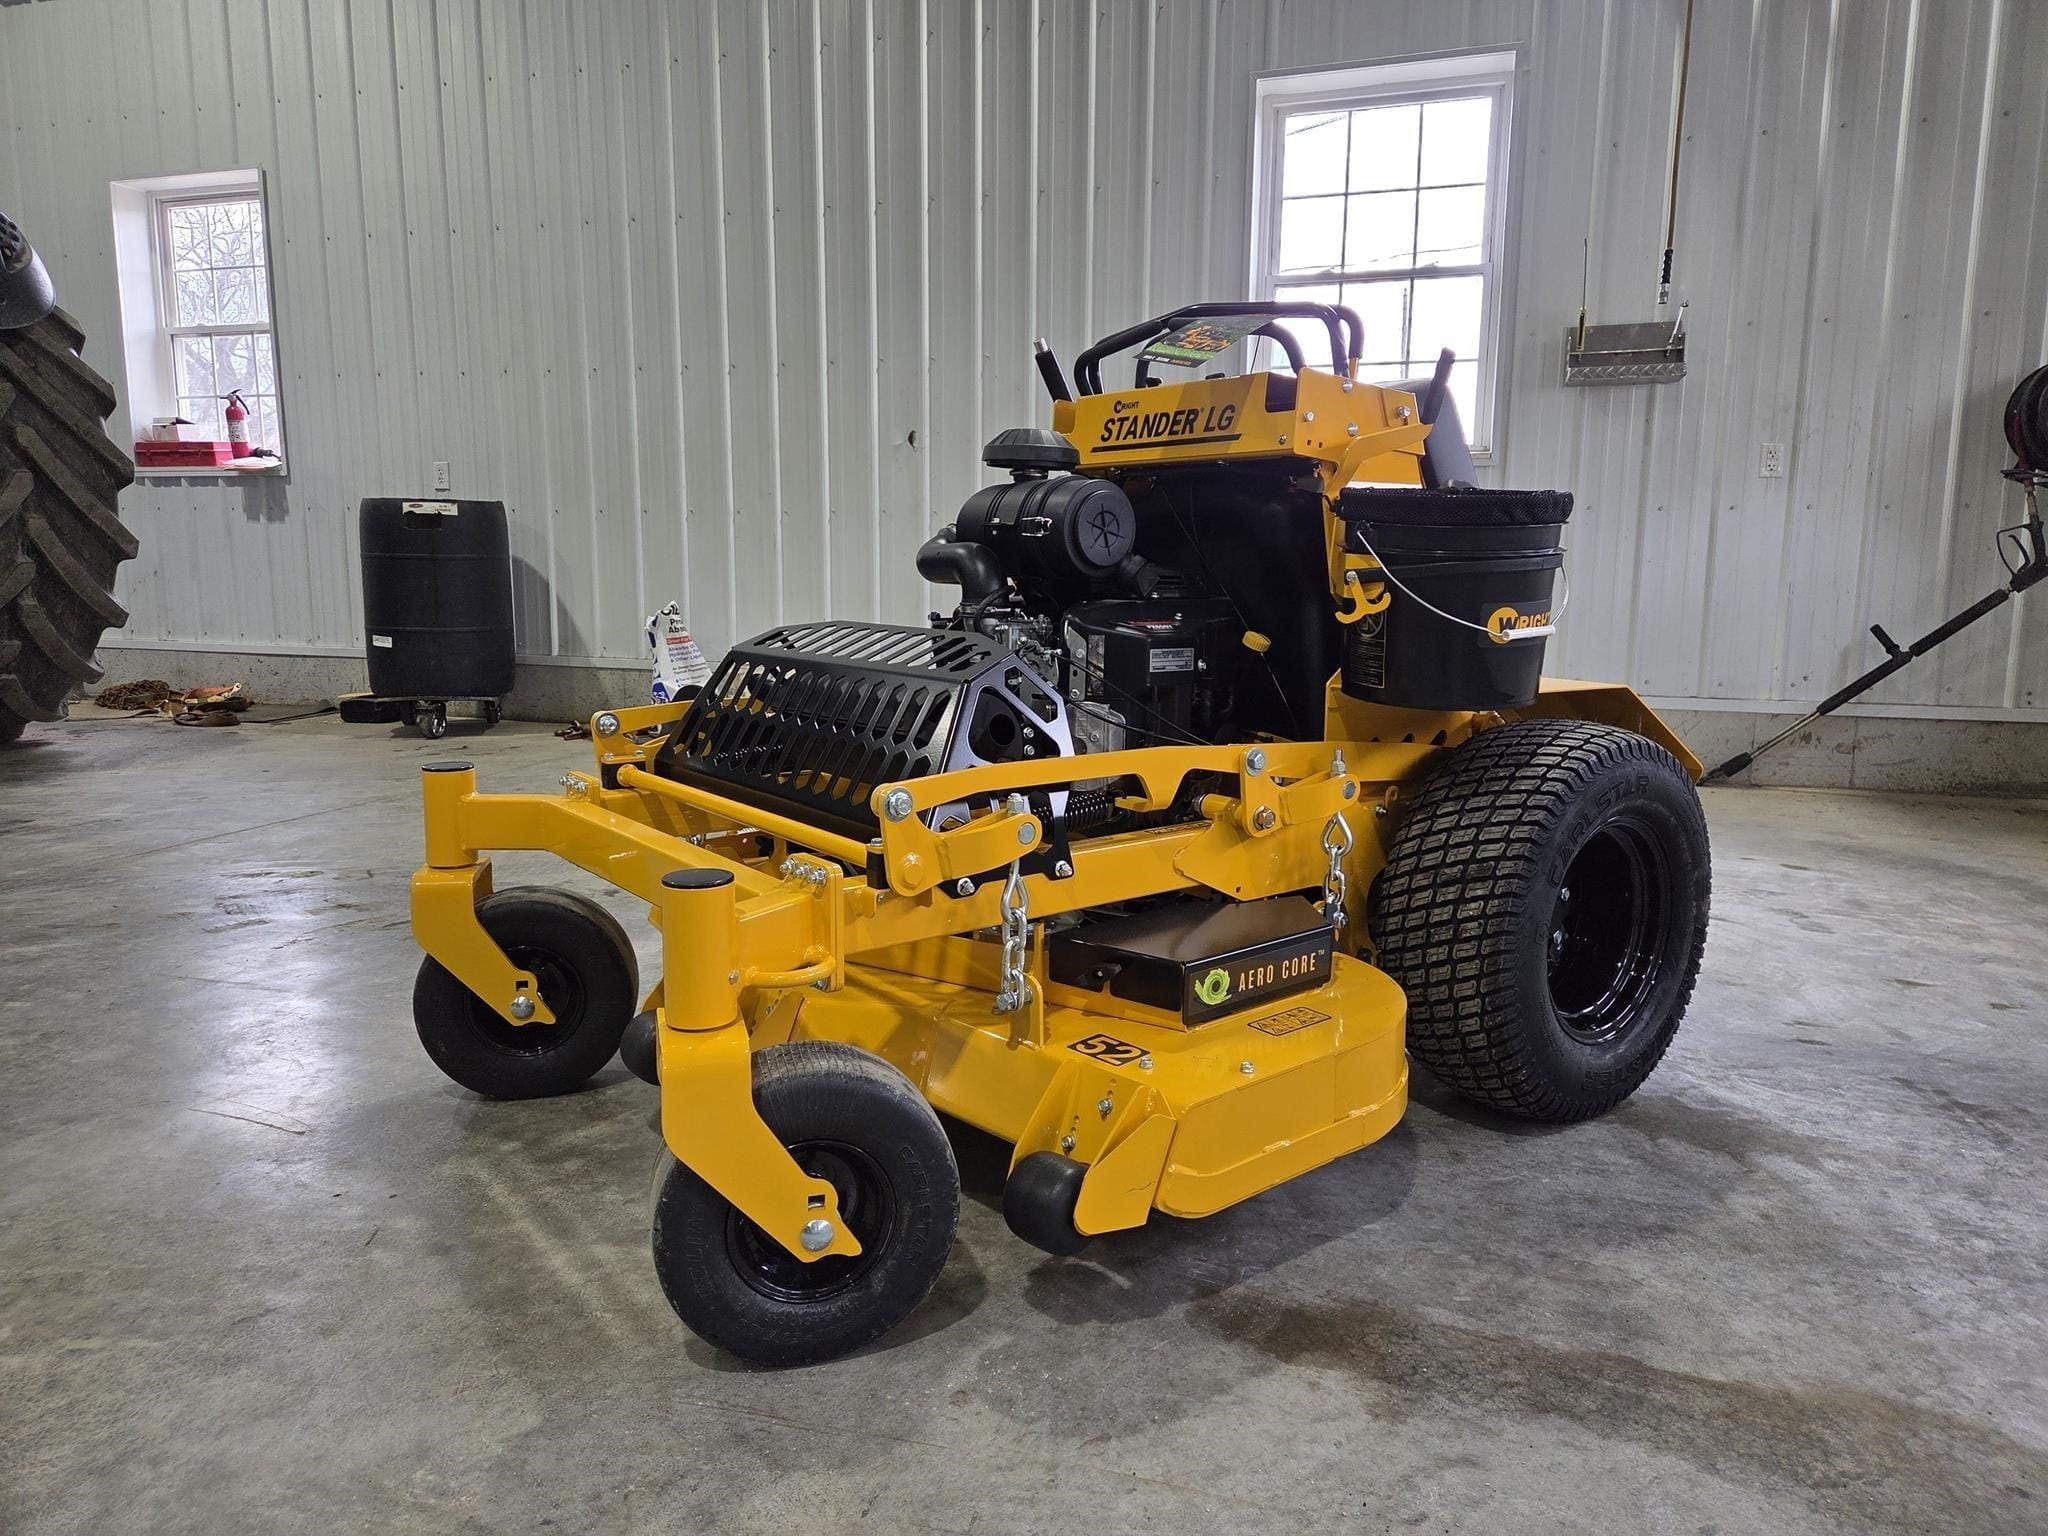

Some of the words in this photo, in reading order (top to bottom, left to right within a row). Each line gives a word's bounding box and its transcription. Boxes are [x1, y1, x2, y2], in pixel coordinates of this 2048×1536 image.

[1101, 408, 1199, 442] STANDER
[1203, 404, 1236, 432] LG
[1114, 400, 1139, 414] WRIGHT
[1239, 964, 1274, 992] AERO
[1282, 952, 1316, 979] CORE
[1076, 1036, 1141, 1065] 52
